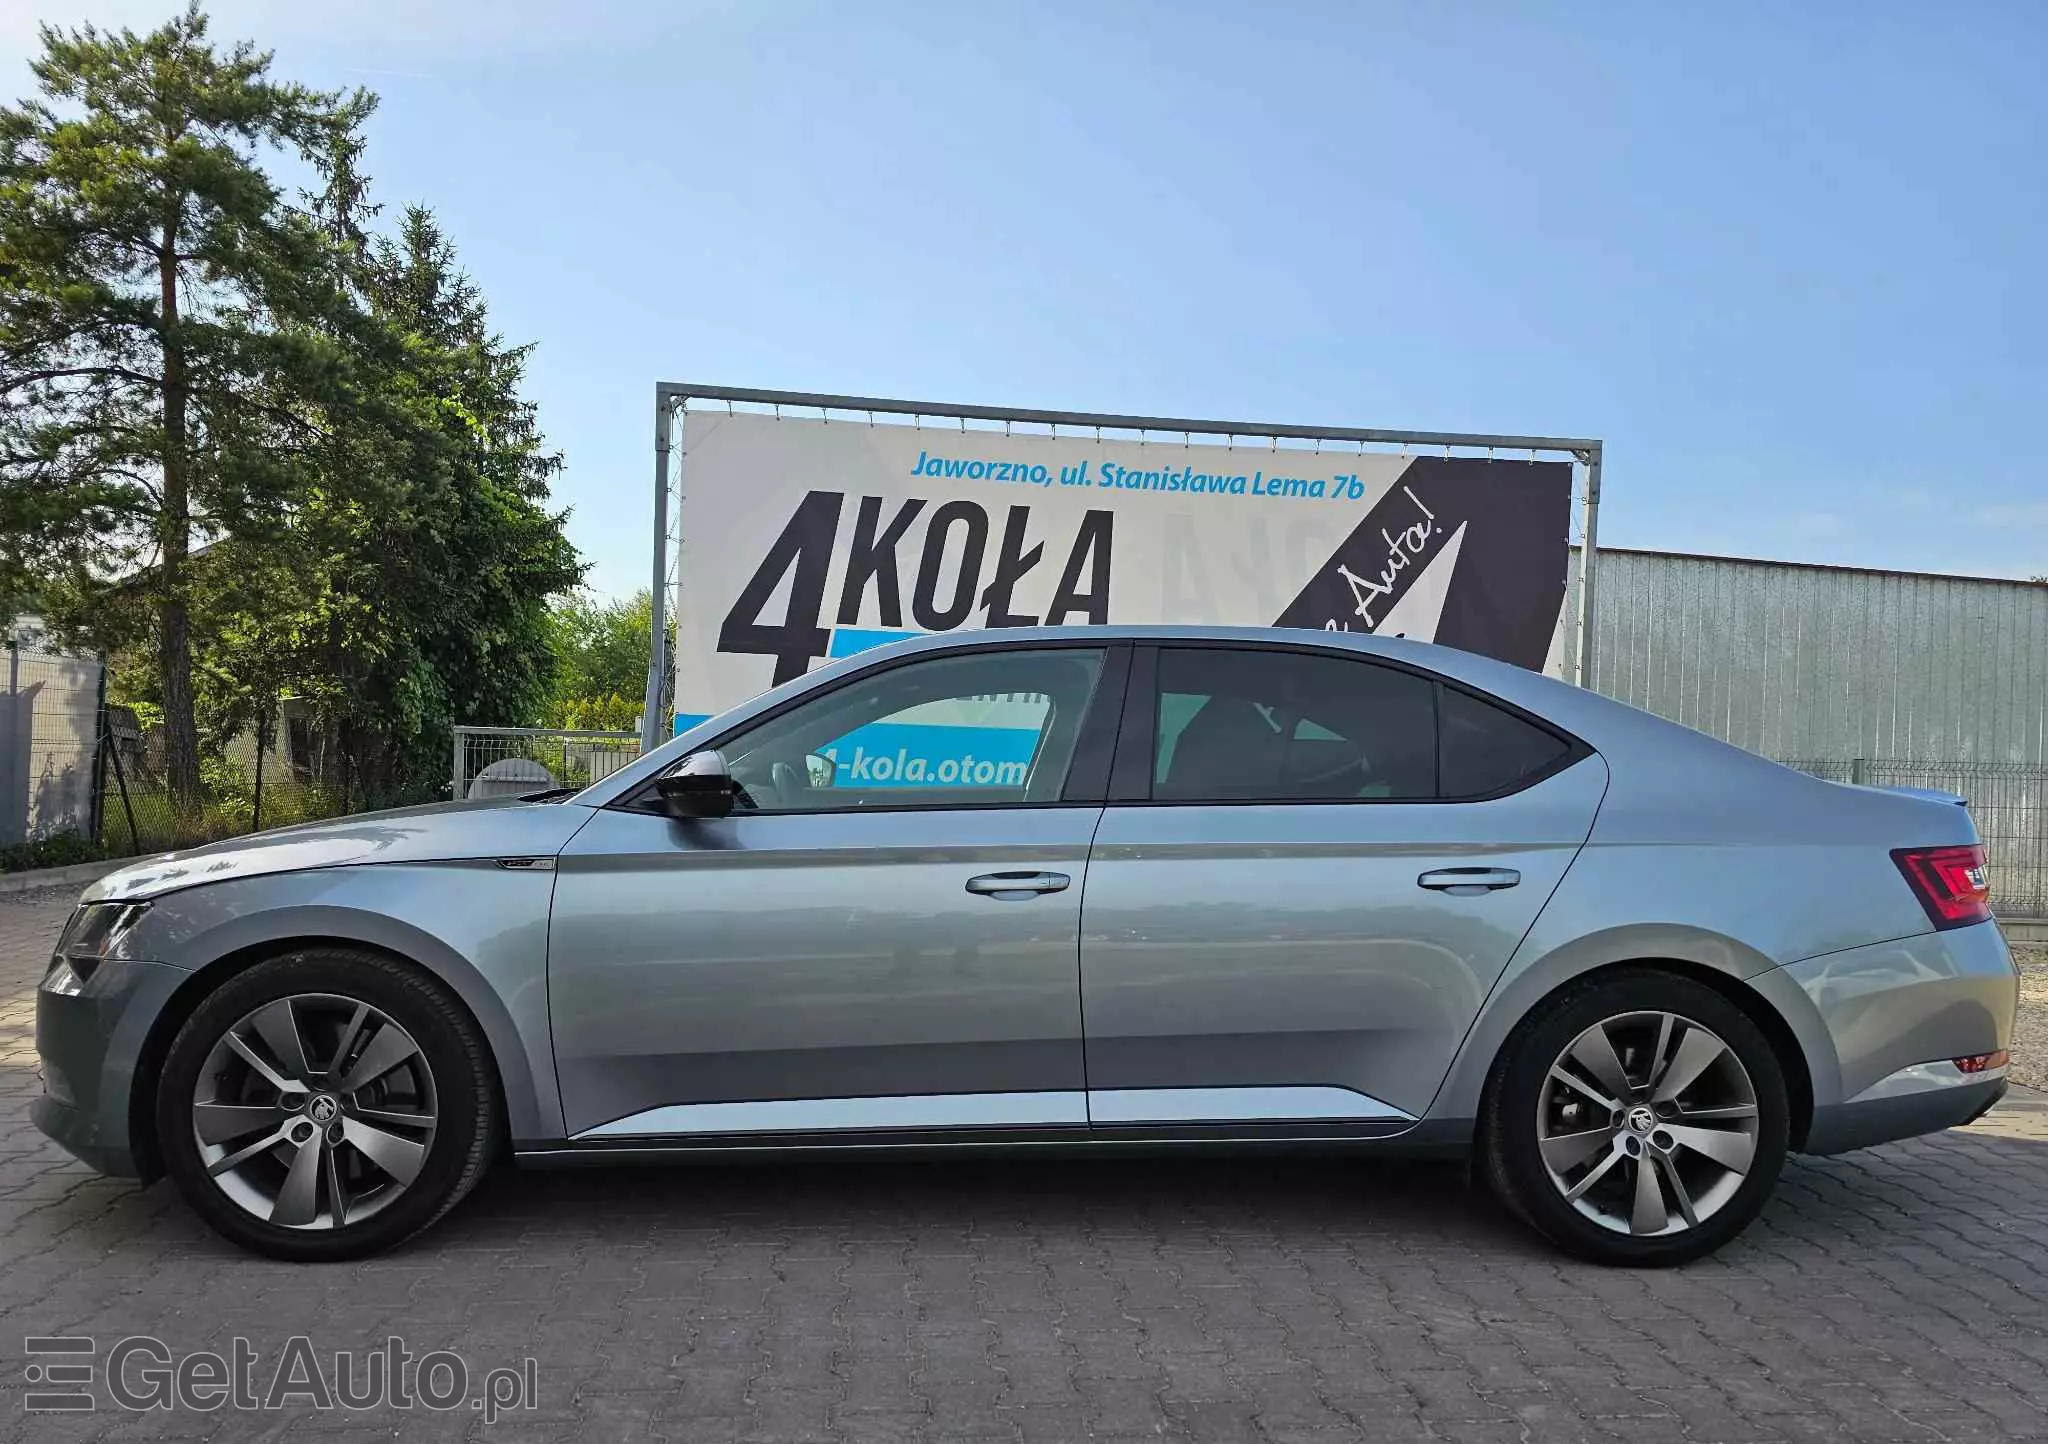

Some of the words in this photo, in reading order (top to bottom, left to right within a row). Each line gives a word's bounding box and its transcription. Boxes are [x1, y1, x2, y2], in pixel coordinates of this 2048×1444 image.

[910, 451, 1052, 488] Jaworzno,
[1060, 460, 1092, 486] ul.
[1099, 462, 1247, 495] Stanisława
[1252, 471, 1326, 498] Lema
[1331, 475, 1365, 499] 7b
[1337, 486, 1442, 627] Auta!
